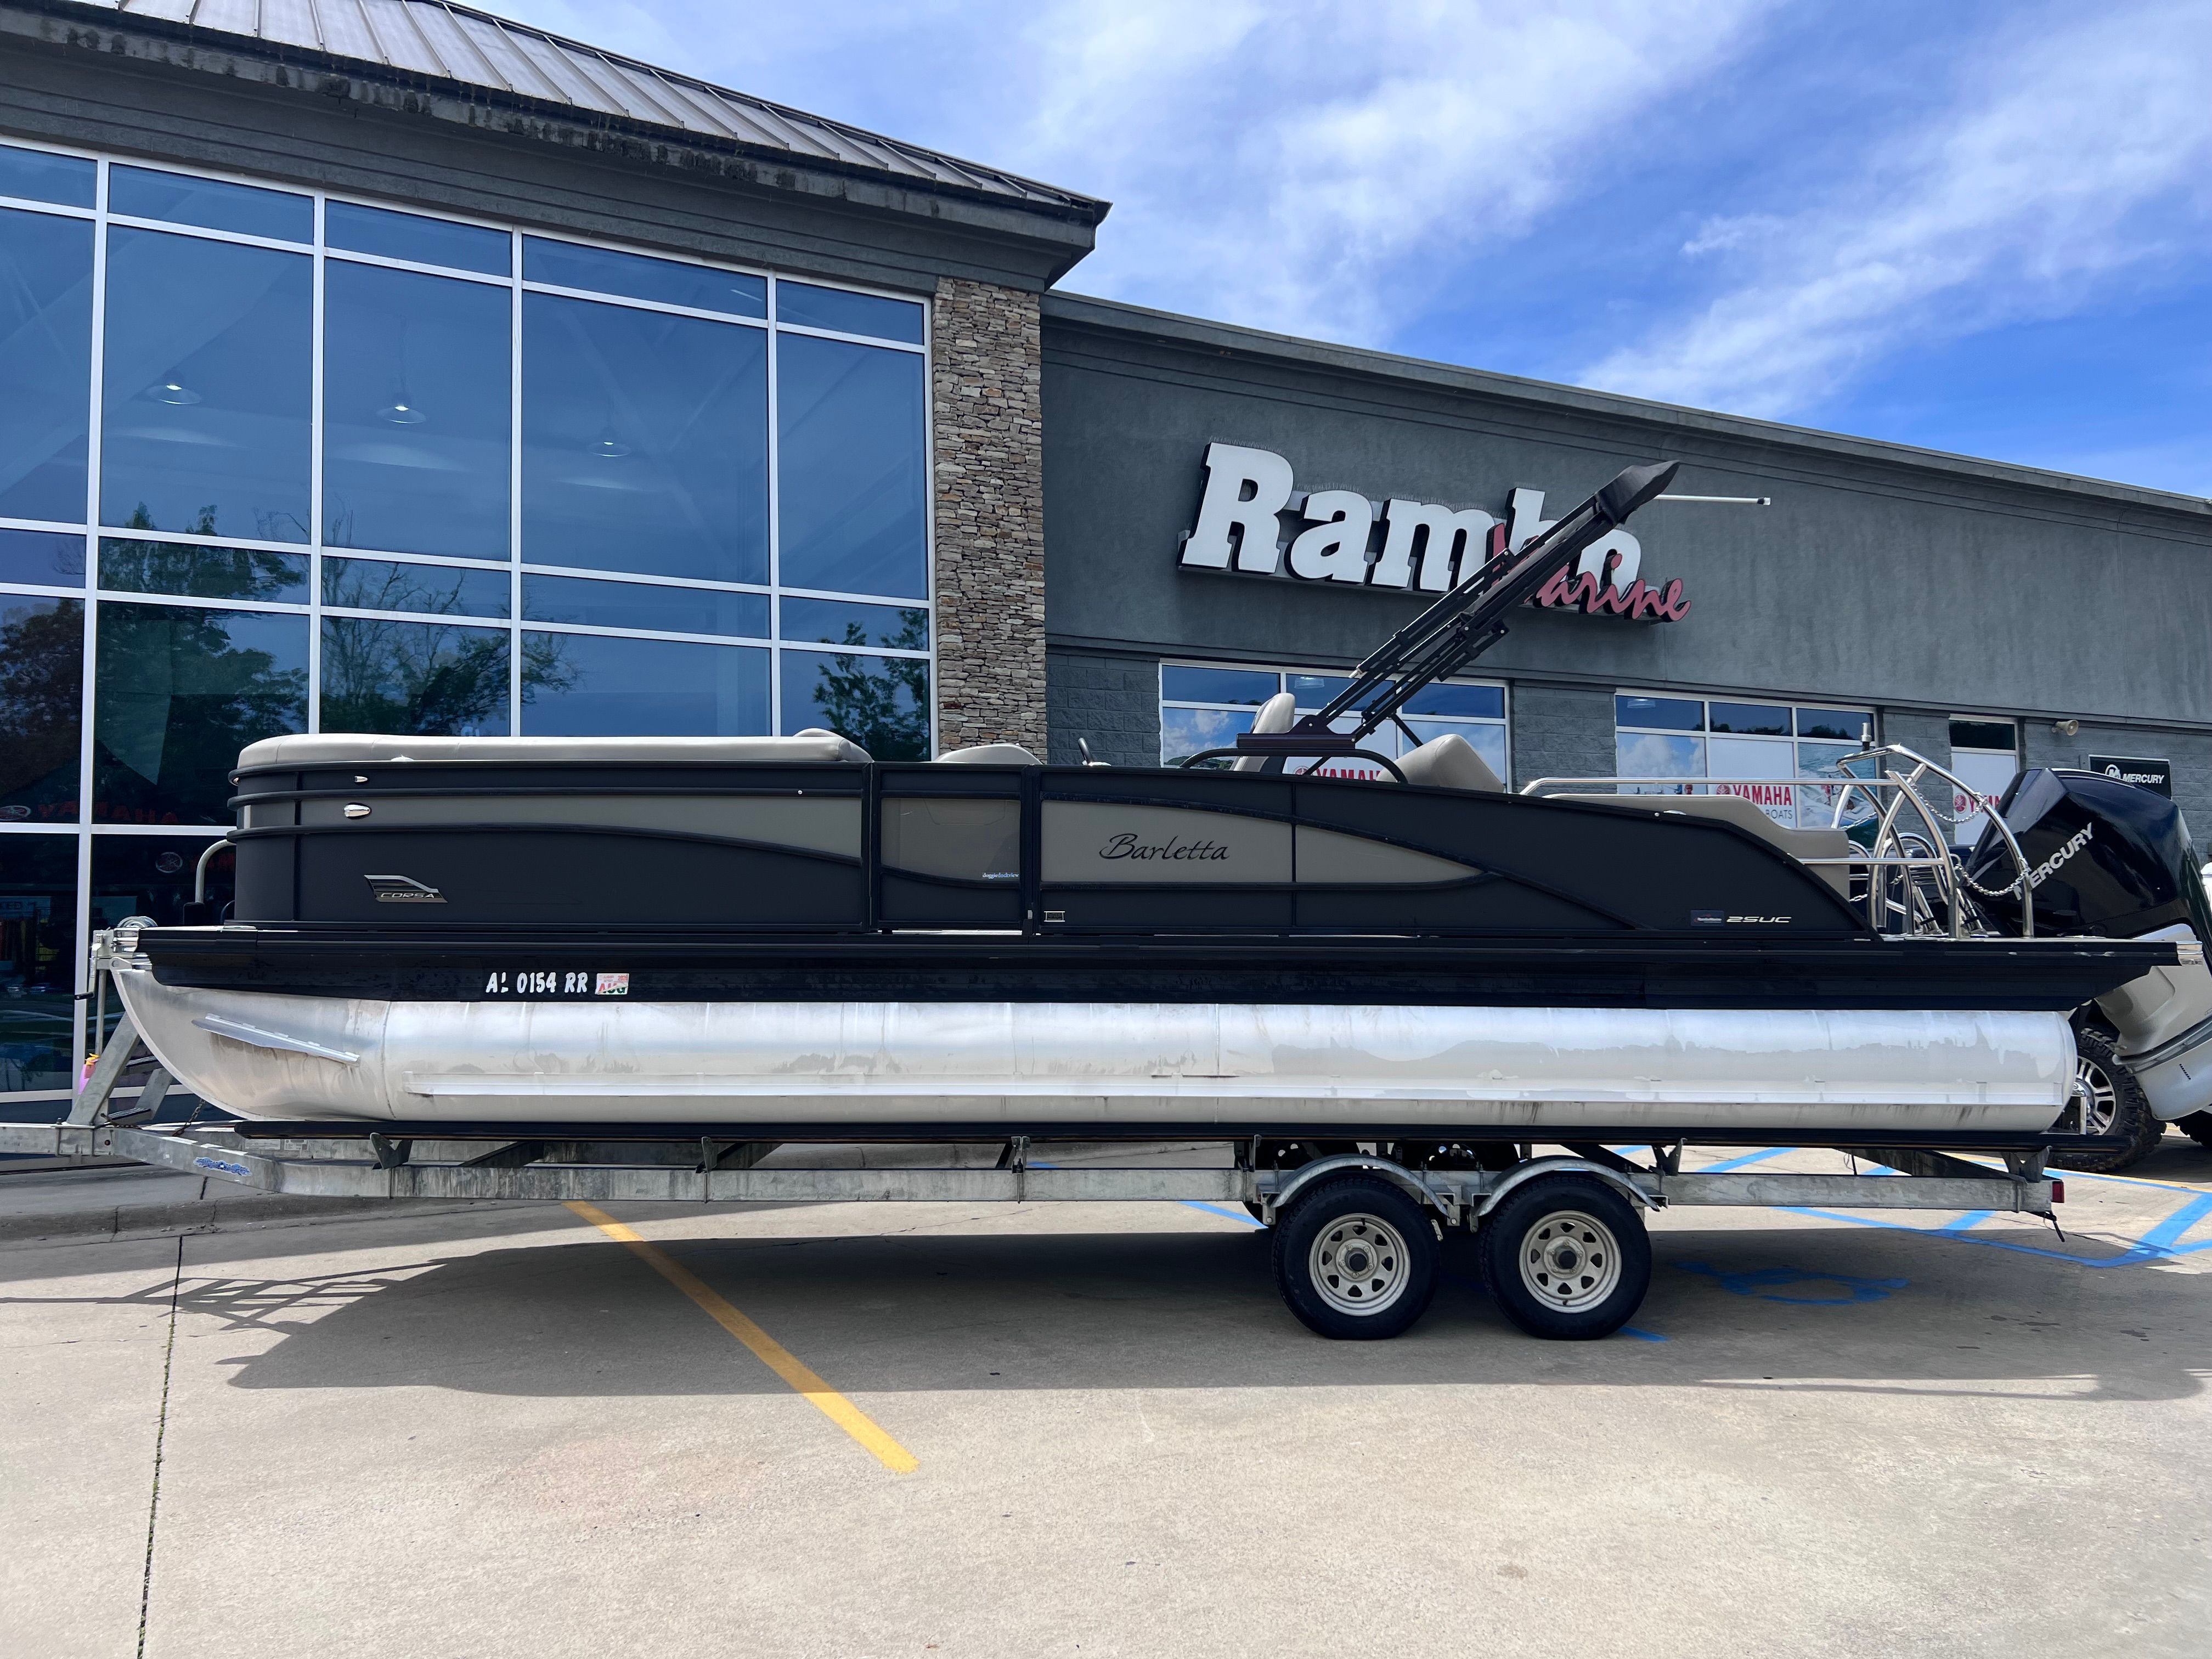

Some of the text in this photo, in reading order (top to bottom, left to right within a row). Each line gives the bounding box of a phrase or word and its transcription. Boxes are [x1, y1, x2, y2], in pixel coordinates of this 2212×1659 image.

[2122, 773, 2165, 784] MERCURY
[1733, 785, 1792, 806] YAMAHA
[1099, 833, 1230, 860] Barletta
[516, 972, 557, 994] 0154
[564, 972, 589, 994] RR
[598, 983, 627, 994] AUG
